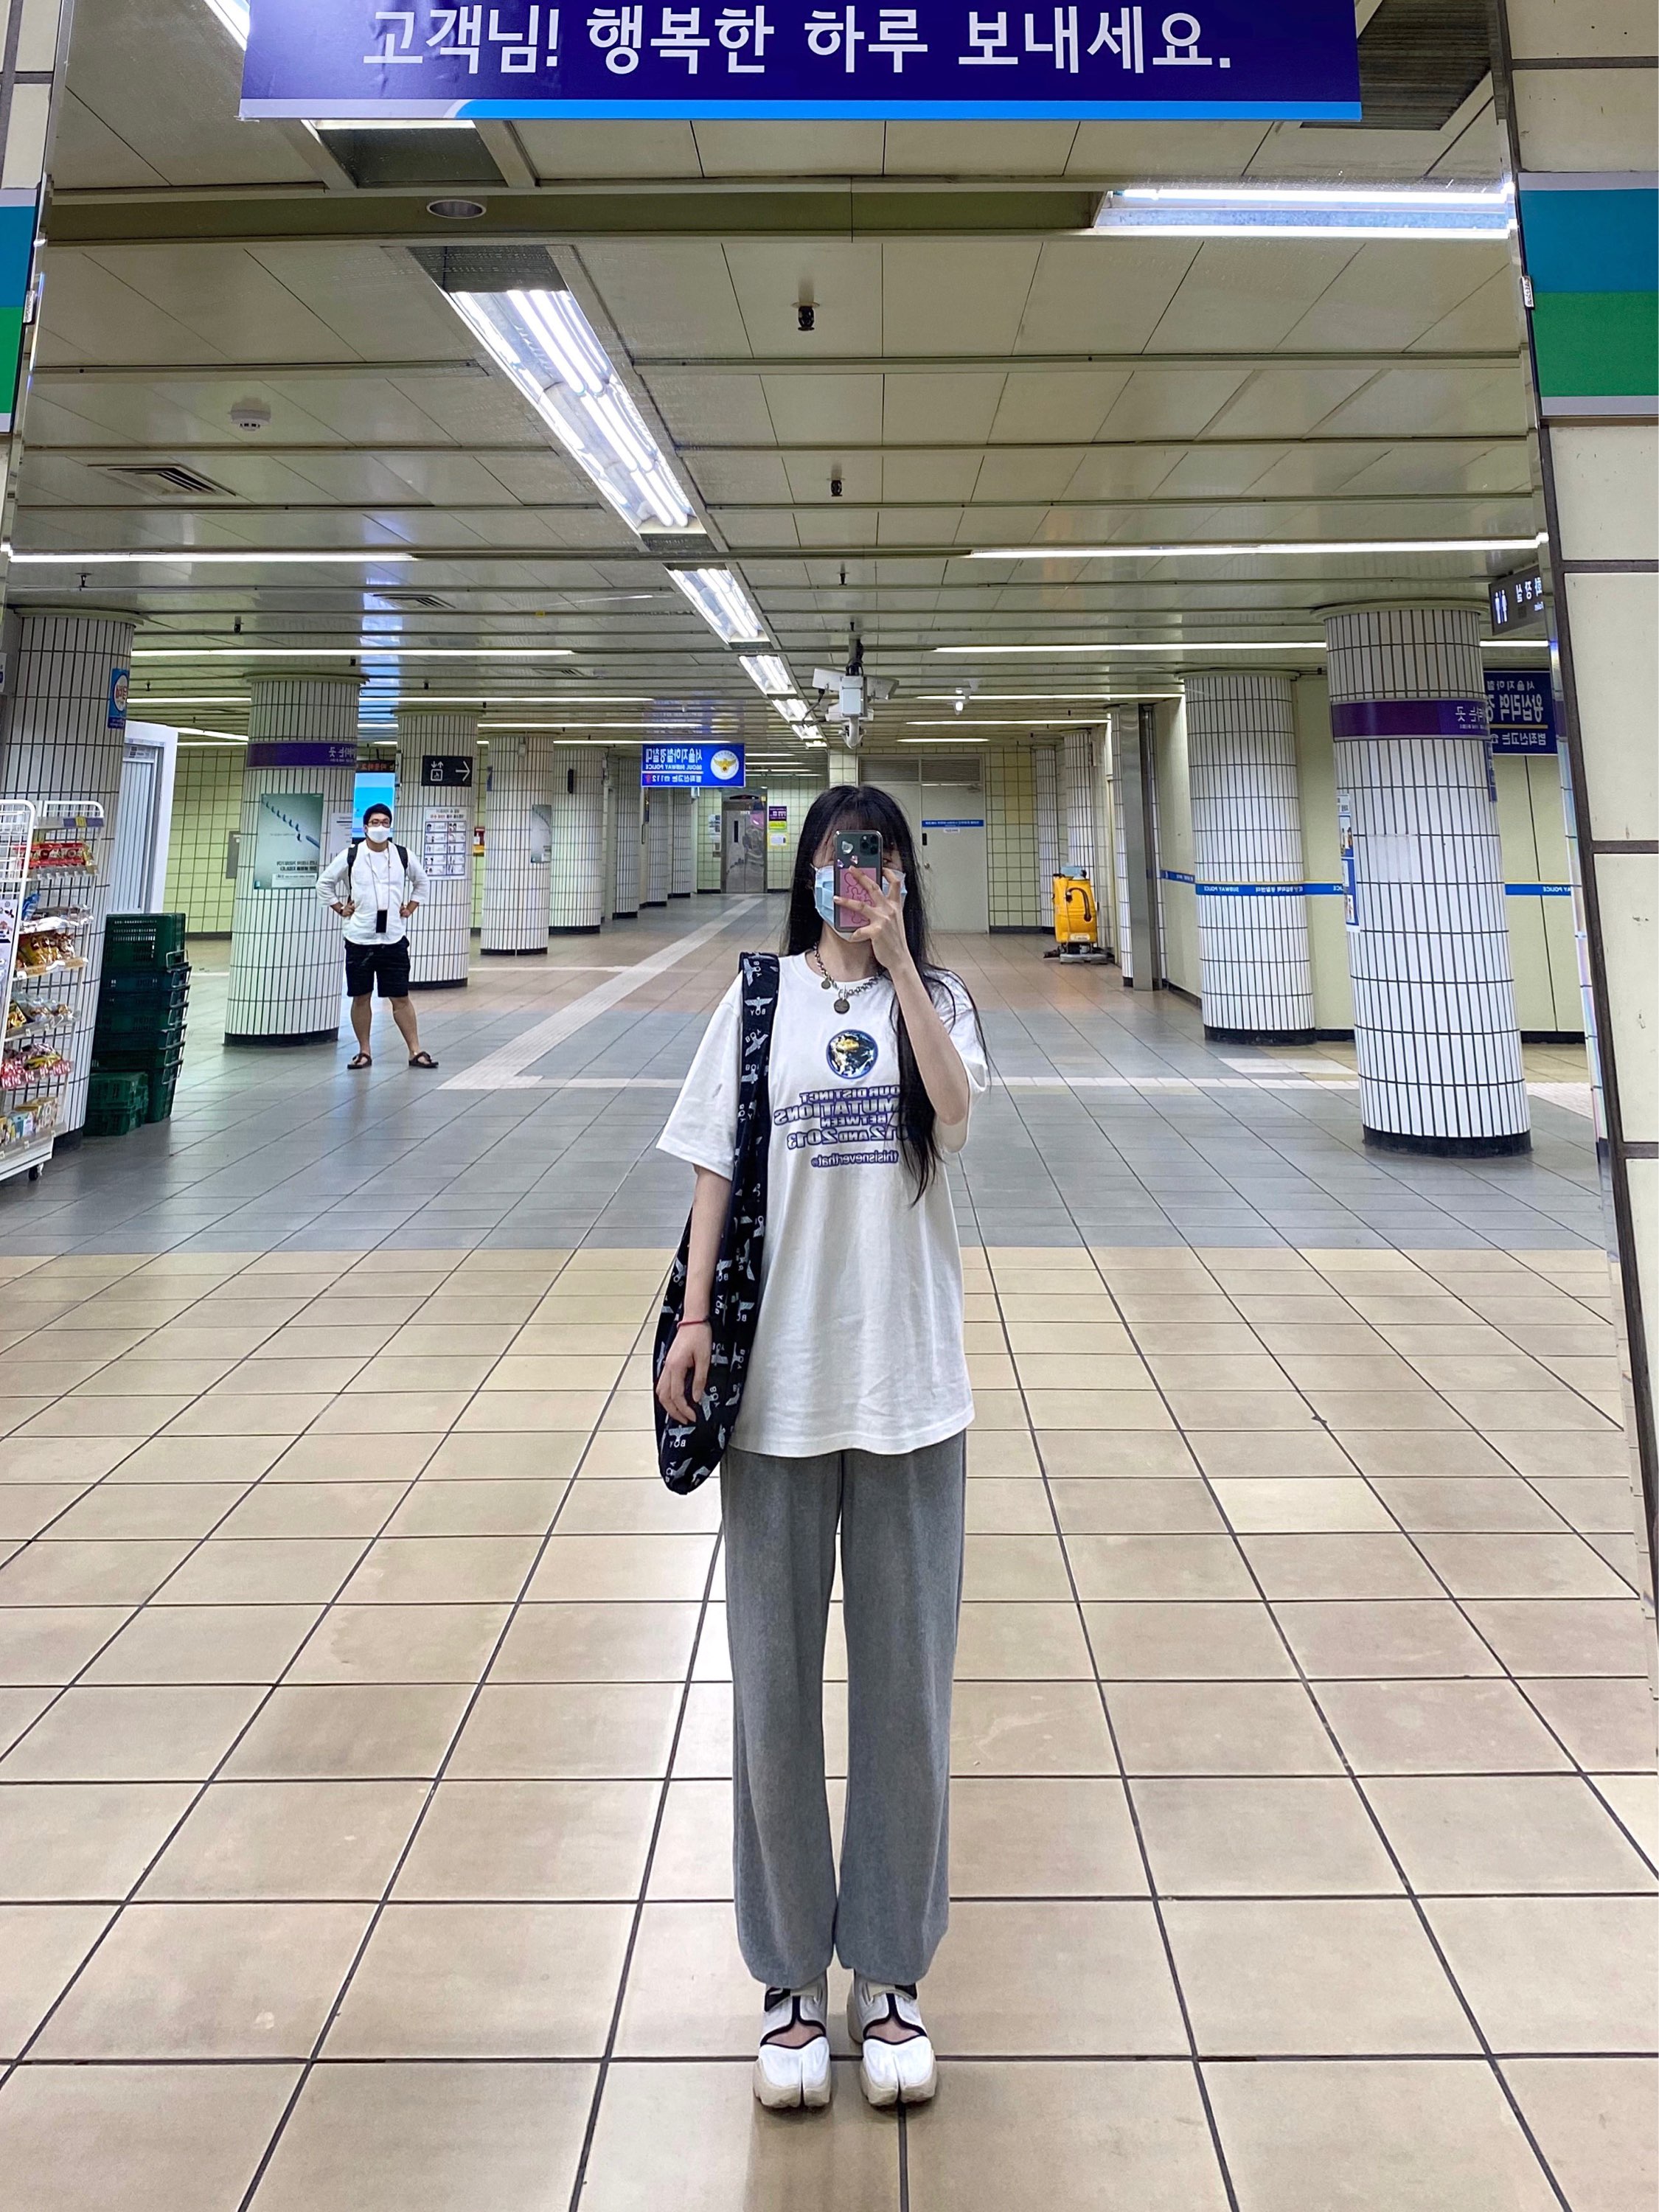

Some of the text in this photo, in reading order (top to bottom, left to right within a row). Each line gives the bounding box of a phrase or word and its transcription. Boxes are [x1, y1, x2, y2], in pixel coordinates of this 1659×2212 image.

[362, 4, 1231, 74] 고객님! 행복한 하루 보내세요.
